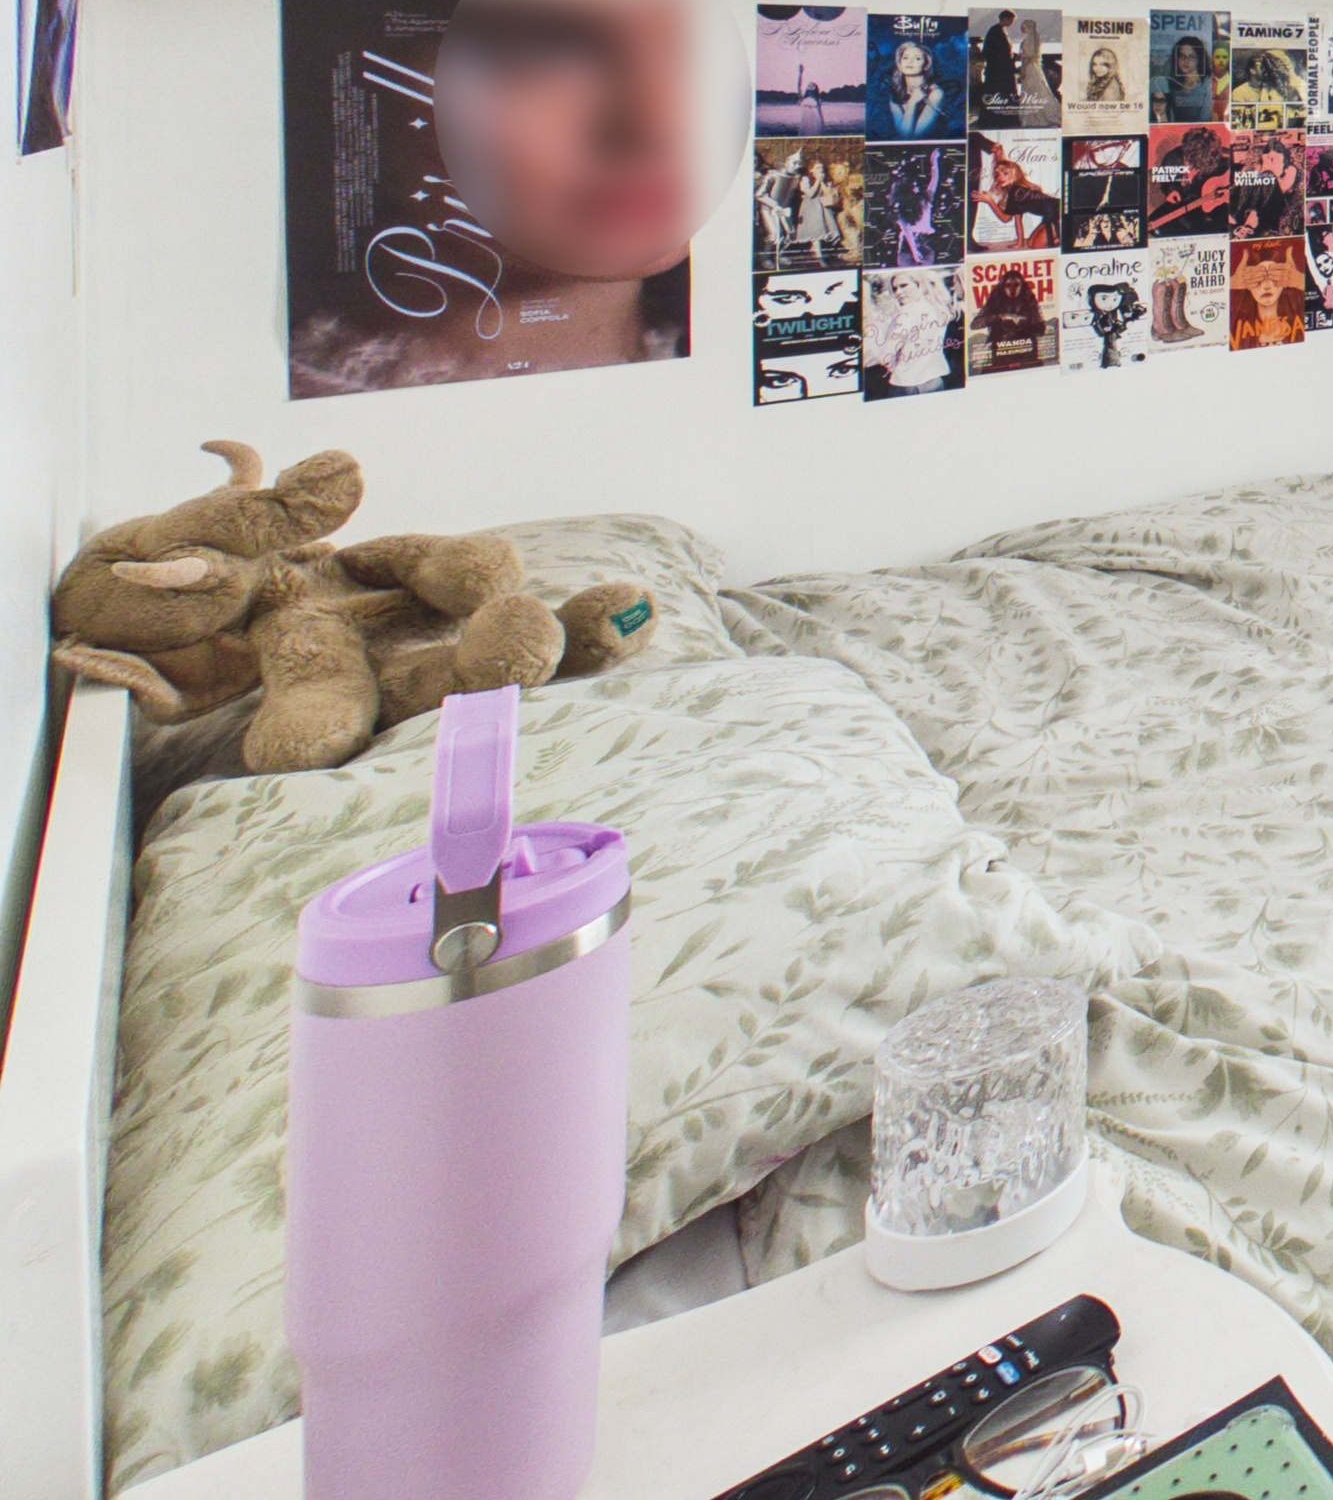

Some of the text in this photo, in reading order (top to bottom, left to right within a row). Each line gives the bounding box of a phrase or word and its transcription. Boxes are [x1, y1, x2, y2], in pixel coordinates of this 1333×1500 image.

[893, 15, 939, 43] Buffy
[1077, 20, 1134, 35] MISSING
[1238, 27, 1305, 38] TAMING 7
[1309, 17, 1320, 70] PEOPLE
[1067, 102, 1144, 111] Would now be 16
[1152, 165, 1191, 175] PATRICK
[1234, 171, 1260, 180] KATIE
[1152, 174, 1176, 183] FEELY
[1234, 177, 1276, 187] WILMOT
[1198, 250, 1226, 263] LUCY
[972, 259, 1054, 283] SCARLET
[1065, 257, 1143, 279] Coraline
[1194, 262, 1226, 275] GRAY
[1190, 275, 1226, 288] BAIRD
[766, 315, 854, 337] TWILIGHT
[996, 338, 1032, 348] WANDA
